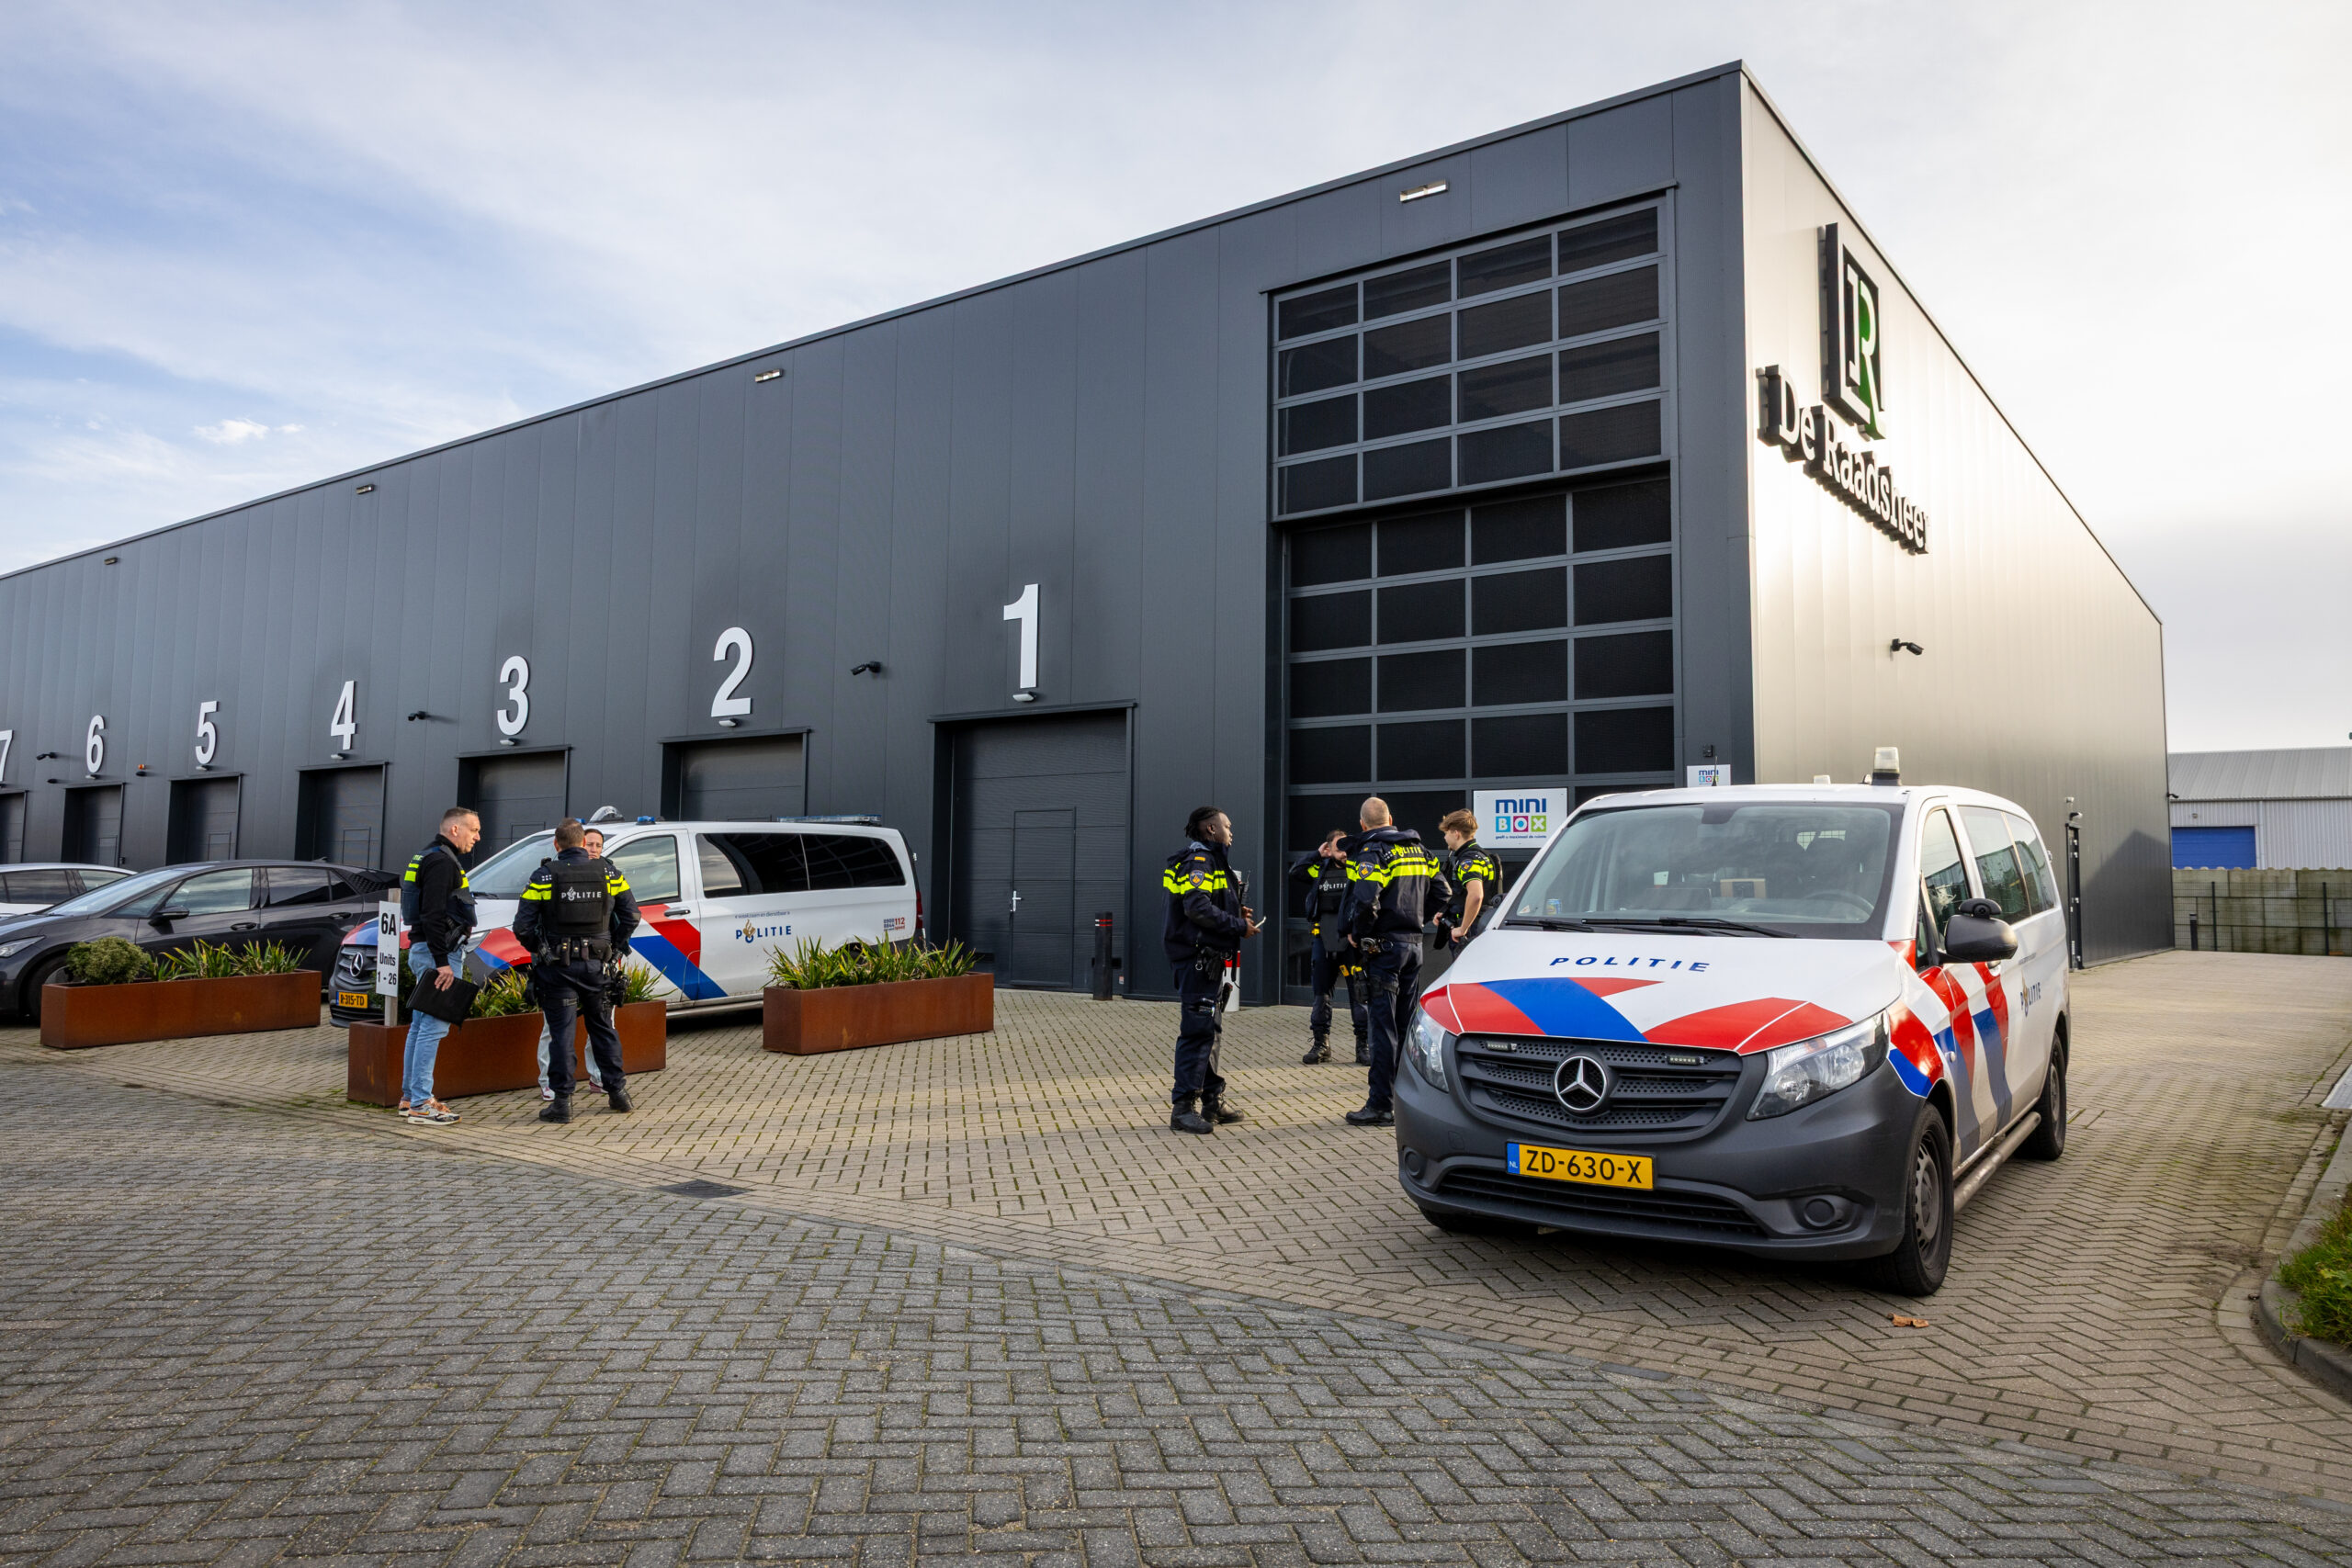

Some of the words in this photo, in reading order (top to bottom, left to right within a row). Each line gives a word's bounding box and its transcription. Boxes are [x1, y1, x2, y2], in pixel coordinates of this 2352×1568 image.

[1756, 365, 1816, 462] De
[1817, 405, 1931, 555] Raadsheer
[1004, 583, 1039, 689] 1
[711, 627, 753, 717] 2
[497, 655, 529, 736] 3
[195, 700, 219, 764] 5
[331, 680, 356, 750] 4
[0, 729, 14, 783] 7
[86, 715, 105, 773] 6
[1496, 816, 1546, 832] BOX
[1391, 844, 1424, 857] POLITIE
[561, 887, 602, 901] POLITIE
[381, 913, 397, 936] 6A
[736, 920, 791, 943] POLITIE
[379, 953, 396, 966] Units
[1549, 956, 1710, 972] POLITIE
[378, 973, 381, 984] 1
[389, 973, 397, 986] 26
[1526, 1149, 1642, 1184] ZD-630-X
